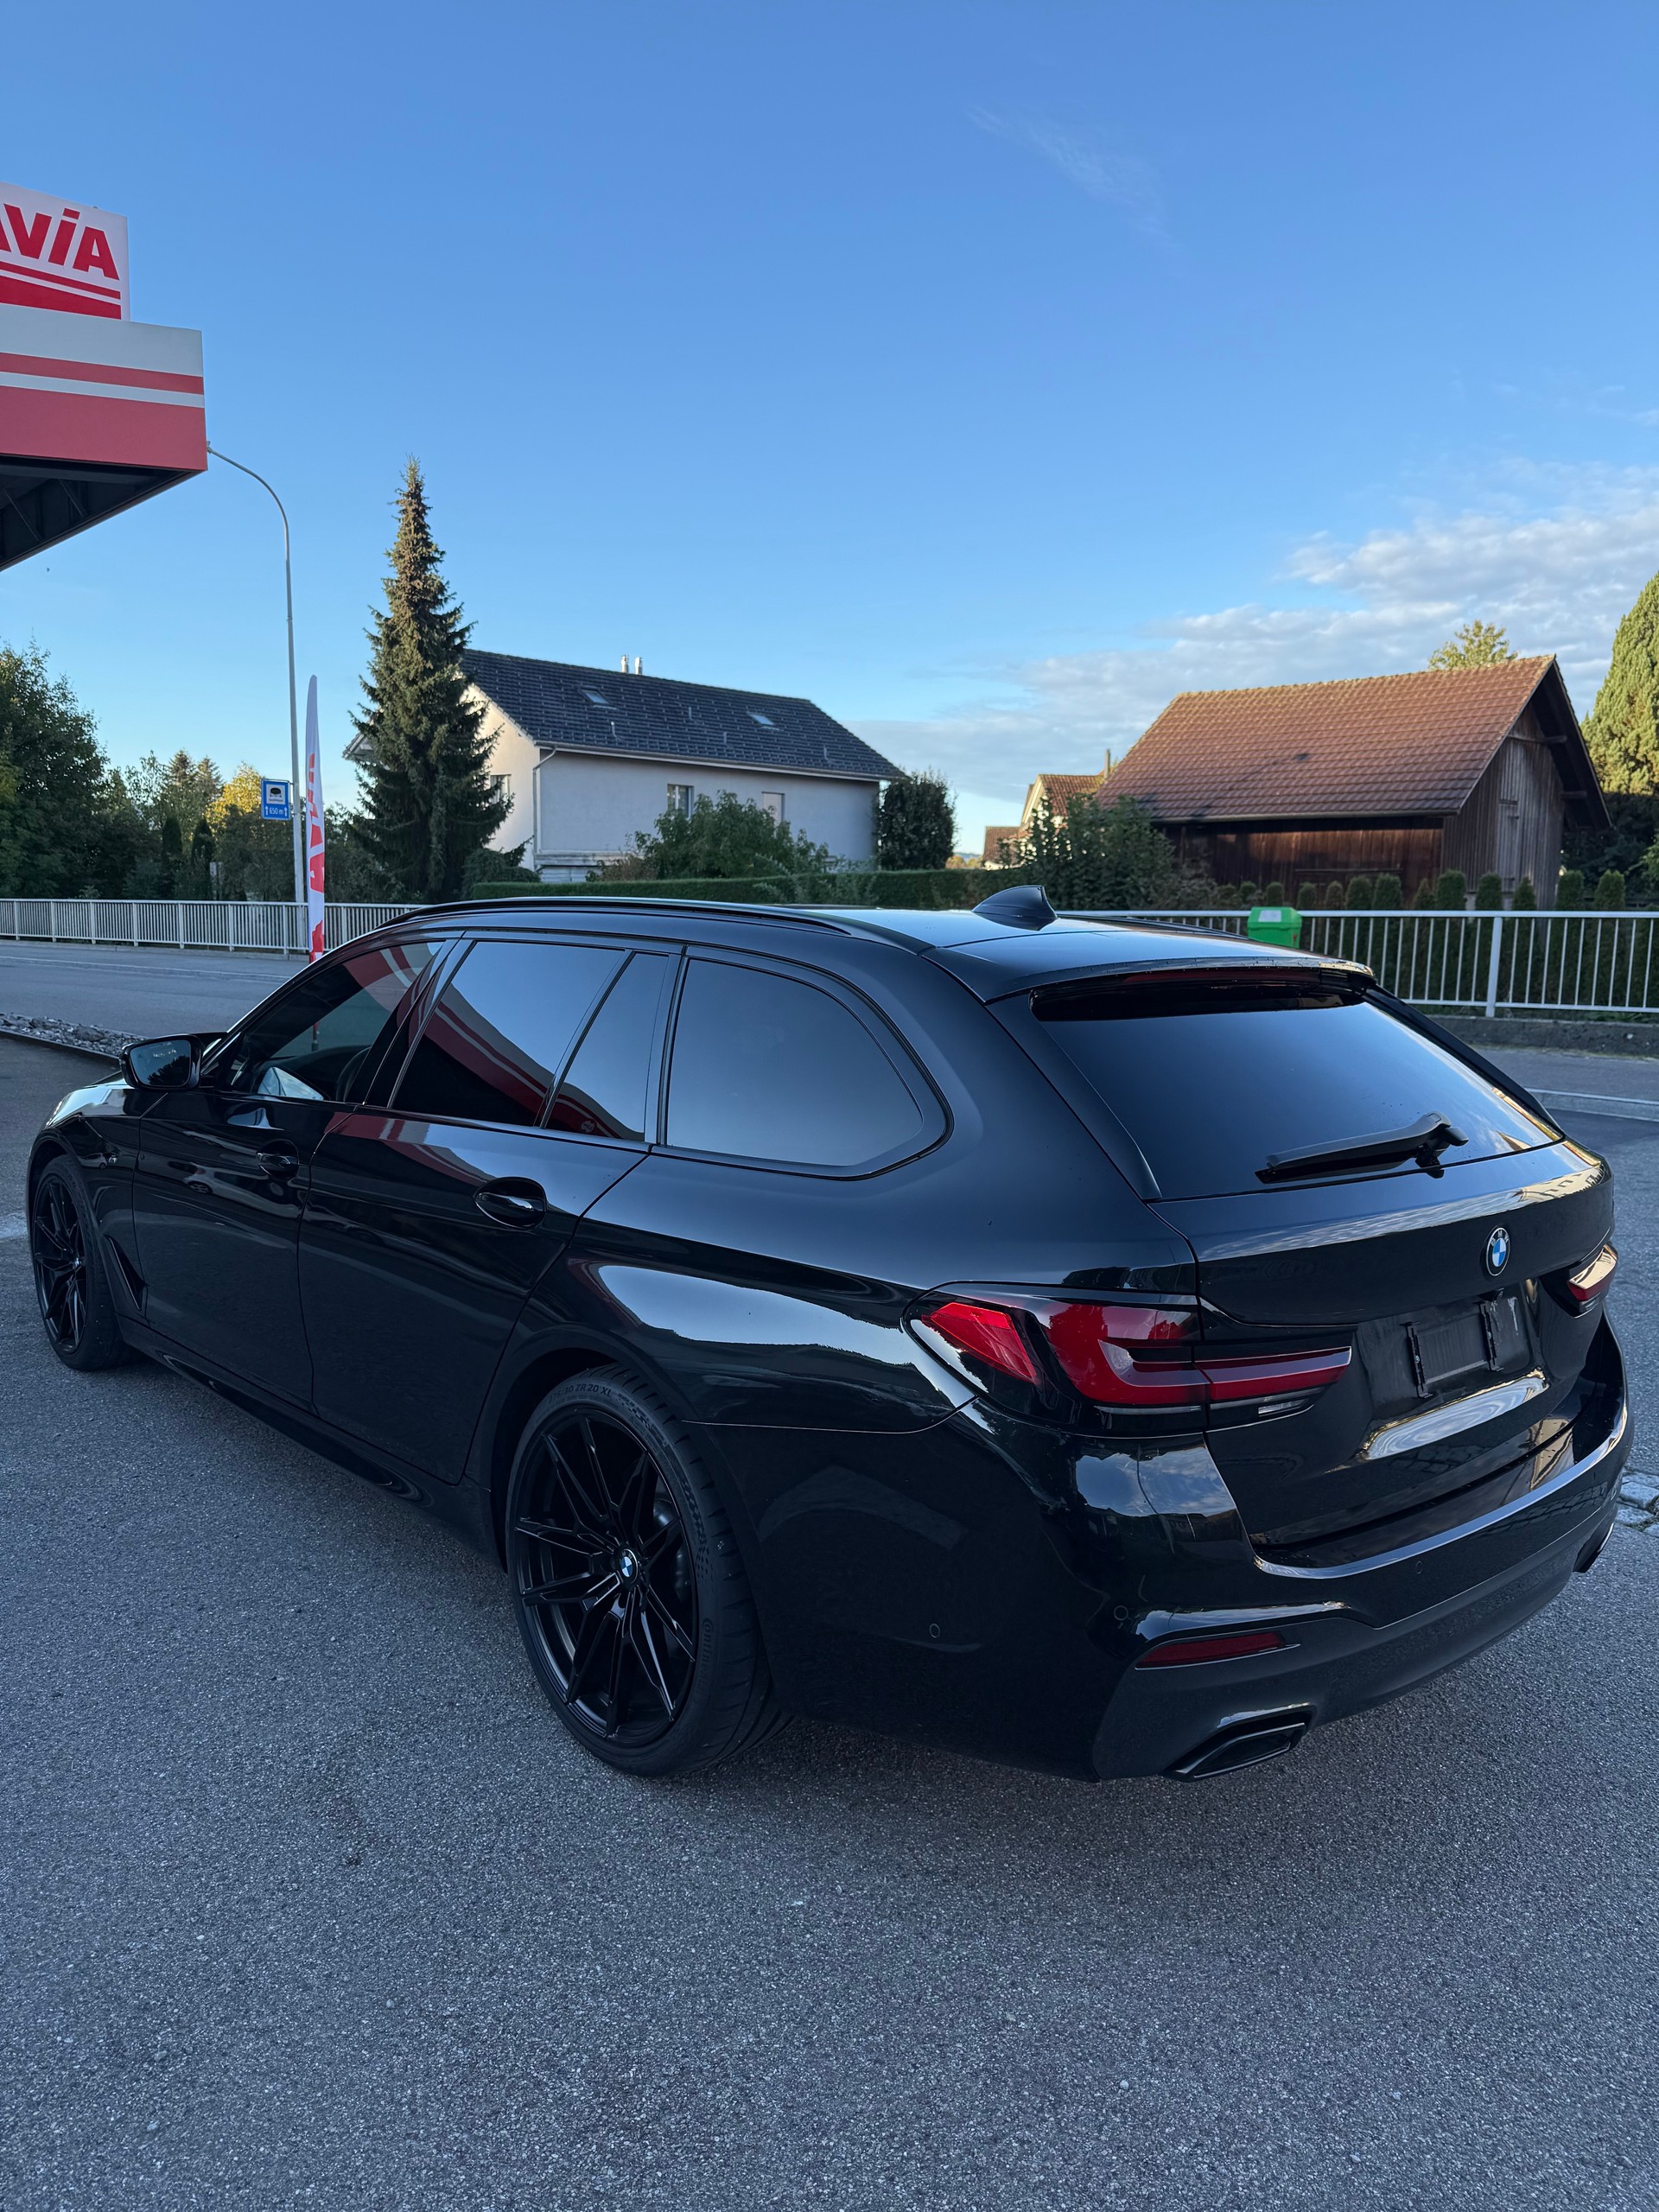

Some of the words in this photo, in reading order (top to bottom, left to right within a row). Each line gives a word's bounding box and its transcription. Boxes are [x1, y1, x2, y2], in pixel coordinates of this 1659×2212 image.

[575, 1383, 587, 1392] ZR
[588, 1383, 600, 1393] 20
[601, 1386, 612, 1398] XL
